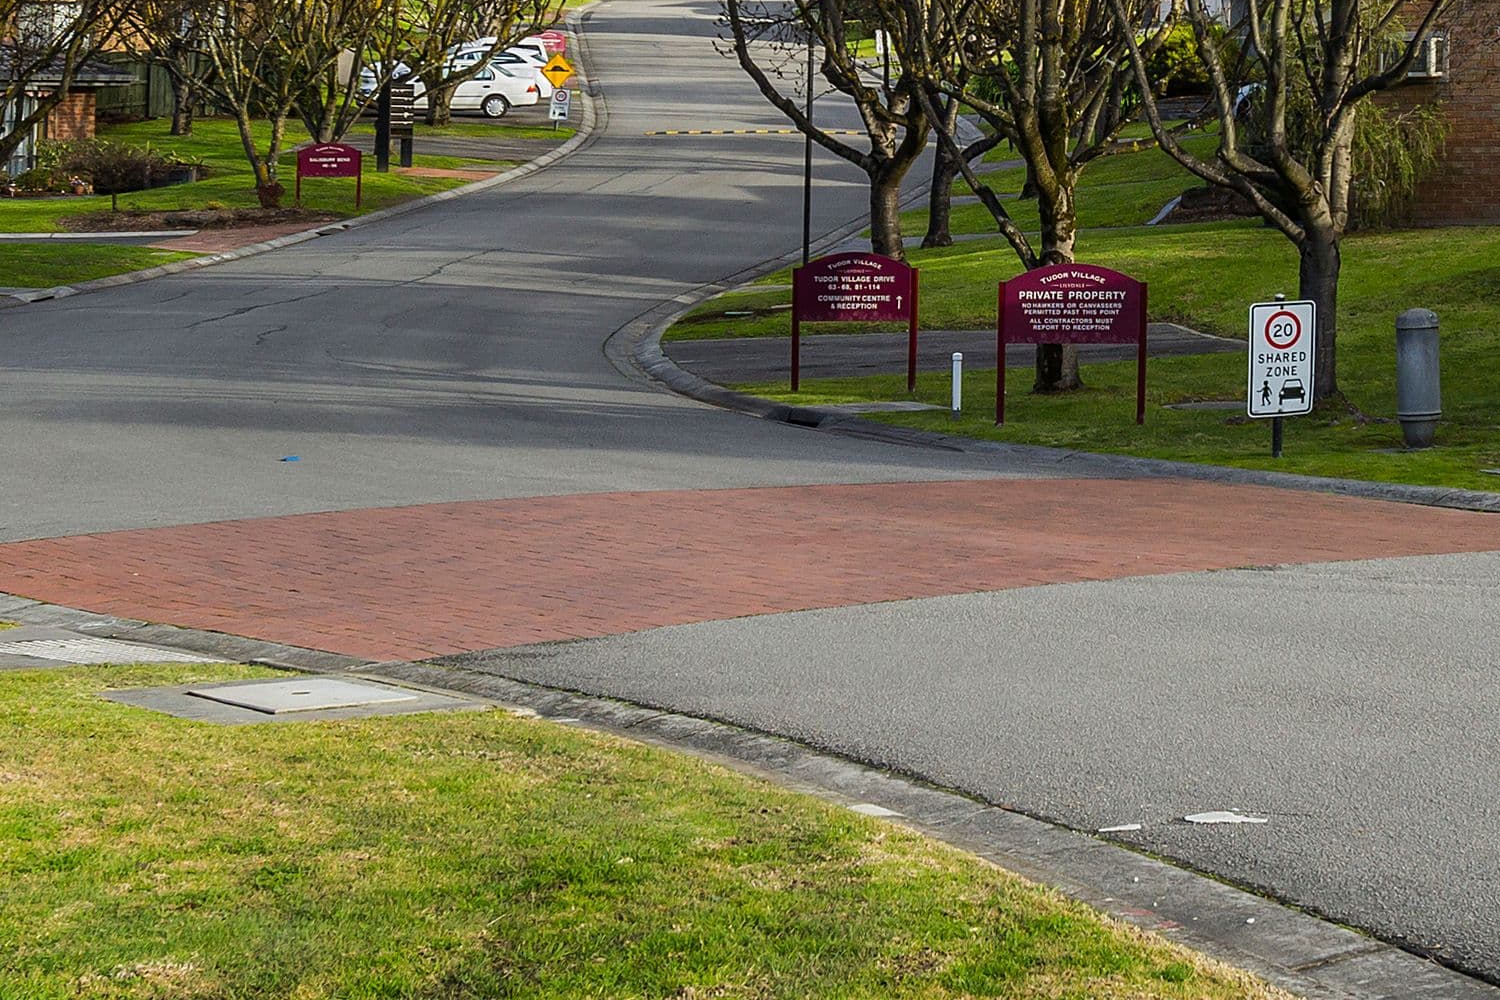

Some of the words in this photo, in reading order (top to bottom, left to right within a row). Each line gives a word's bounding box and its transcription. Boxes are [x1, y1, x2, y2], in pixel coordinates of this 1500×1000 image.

[828, 260, 851, 270] TUDOR
[853, 259, 882, 270] VILLAGE
[1040, 272, 1069, 284] TUDOR
[1071, 271, 1106, 284] VILLAGE
[1019, 291, 1064, 300] PRIVATE
[1068, 291, 1126, 300] PROPERTY
[1273, 323, 1293, 338] 20
[1258, 352, 1307, 364] SHARED
[1266, 366, 1298, 377] ZONE
